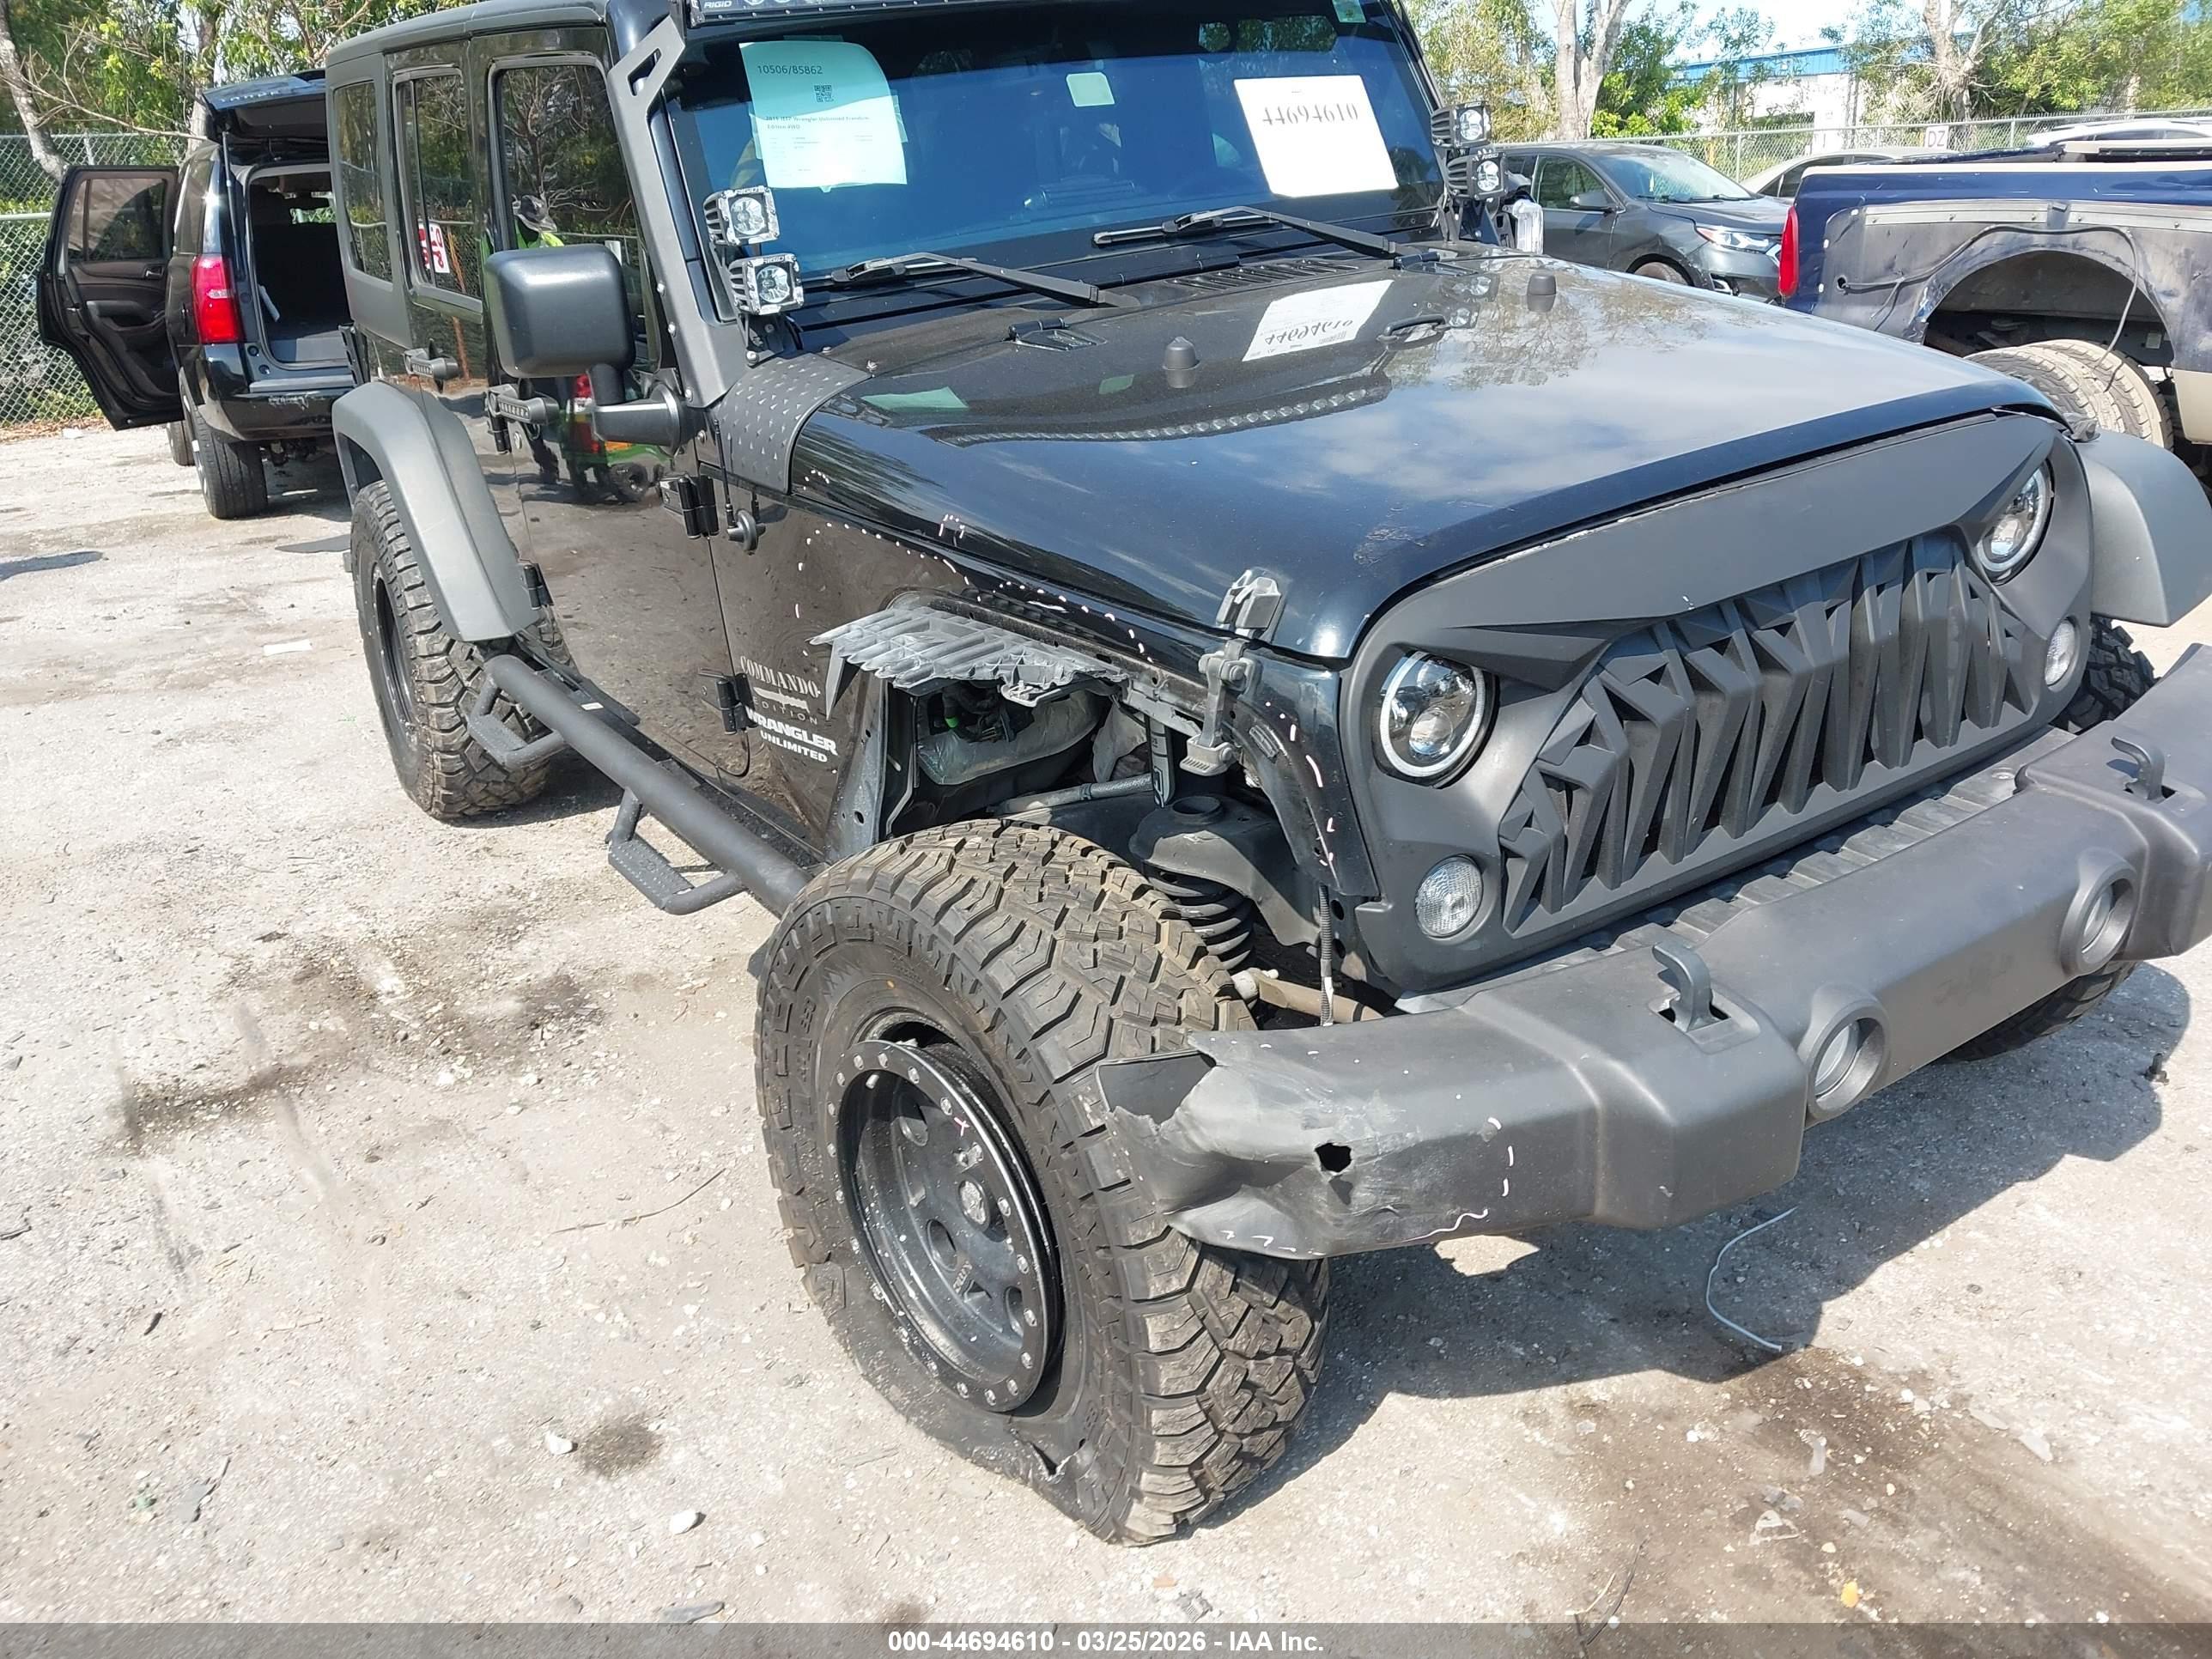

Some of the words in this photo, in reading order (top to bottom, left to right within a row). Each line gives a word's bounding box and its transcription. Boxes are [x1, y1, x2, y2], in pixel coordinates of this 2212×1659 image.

[757, 64, 823, 75] 10506/85862
[763, 255, 785, 264] RIGID
[1264, 319, 1354, 345] 44694610
[740, 655, 818, 699] COMMANDO
[753, 696, 817, 725] EDITION
[744, 705, 839, 757] WRANGLER
[760, 730, 828, 763] UNLIMITED
